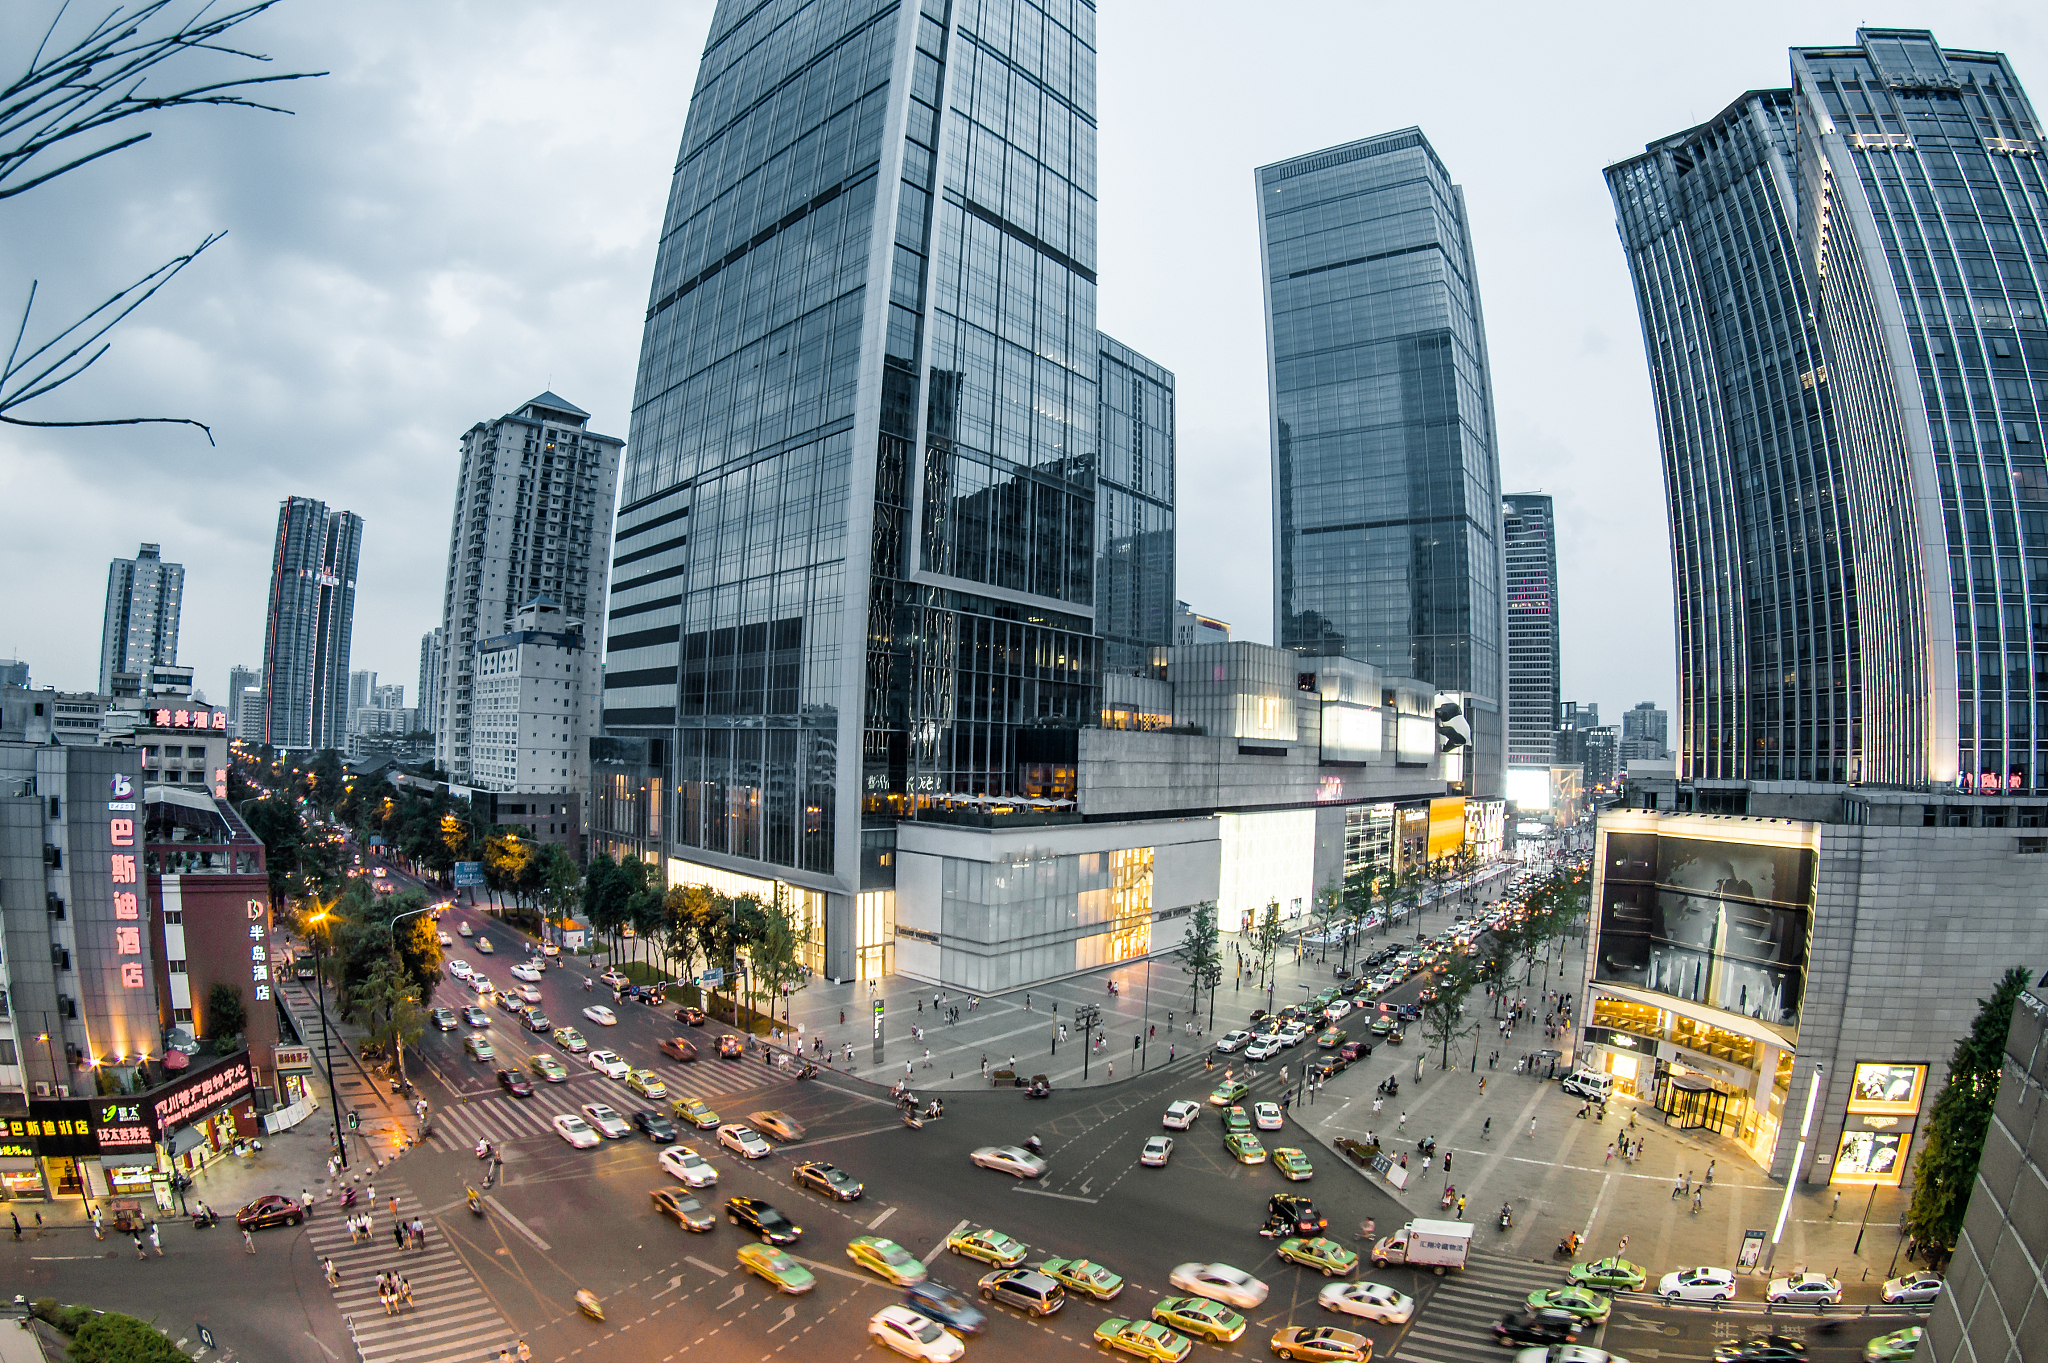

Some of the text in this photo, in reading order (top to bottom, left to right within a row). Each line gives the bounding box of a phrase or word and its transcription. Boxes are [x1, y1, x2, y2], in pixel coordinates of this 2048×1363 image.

[156, 708, 226, 729] 美美酒店
[110, 818, 145, 988] 巴斯迪酒店
[249, 924, 270, 1001] 半岛酒店
[10, 1120, 89, 1137] 巴斯迪酒店
